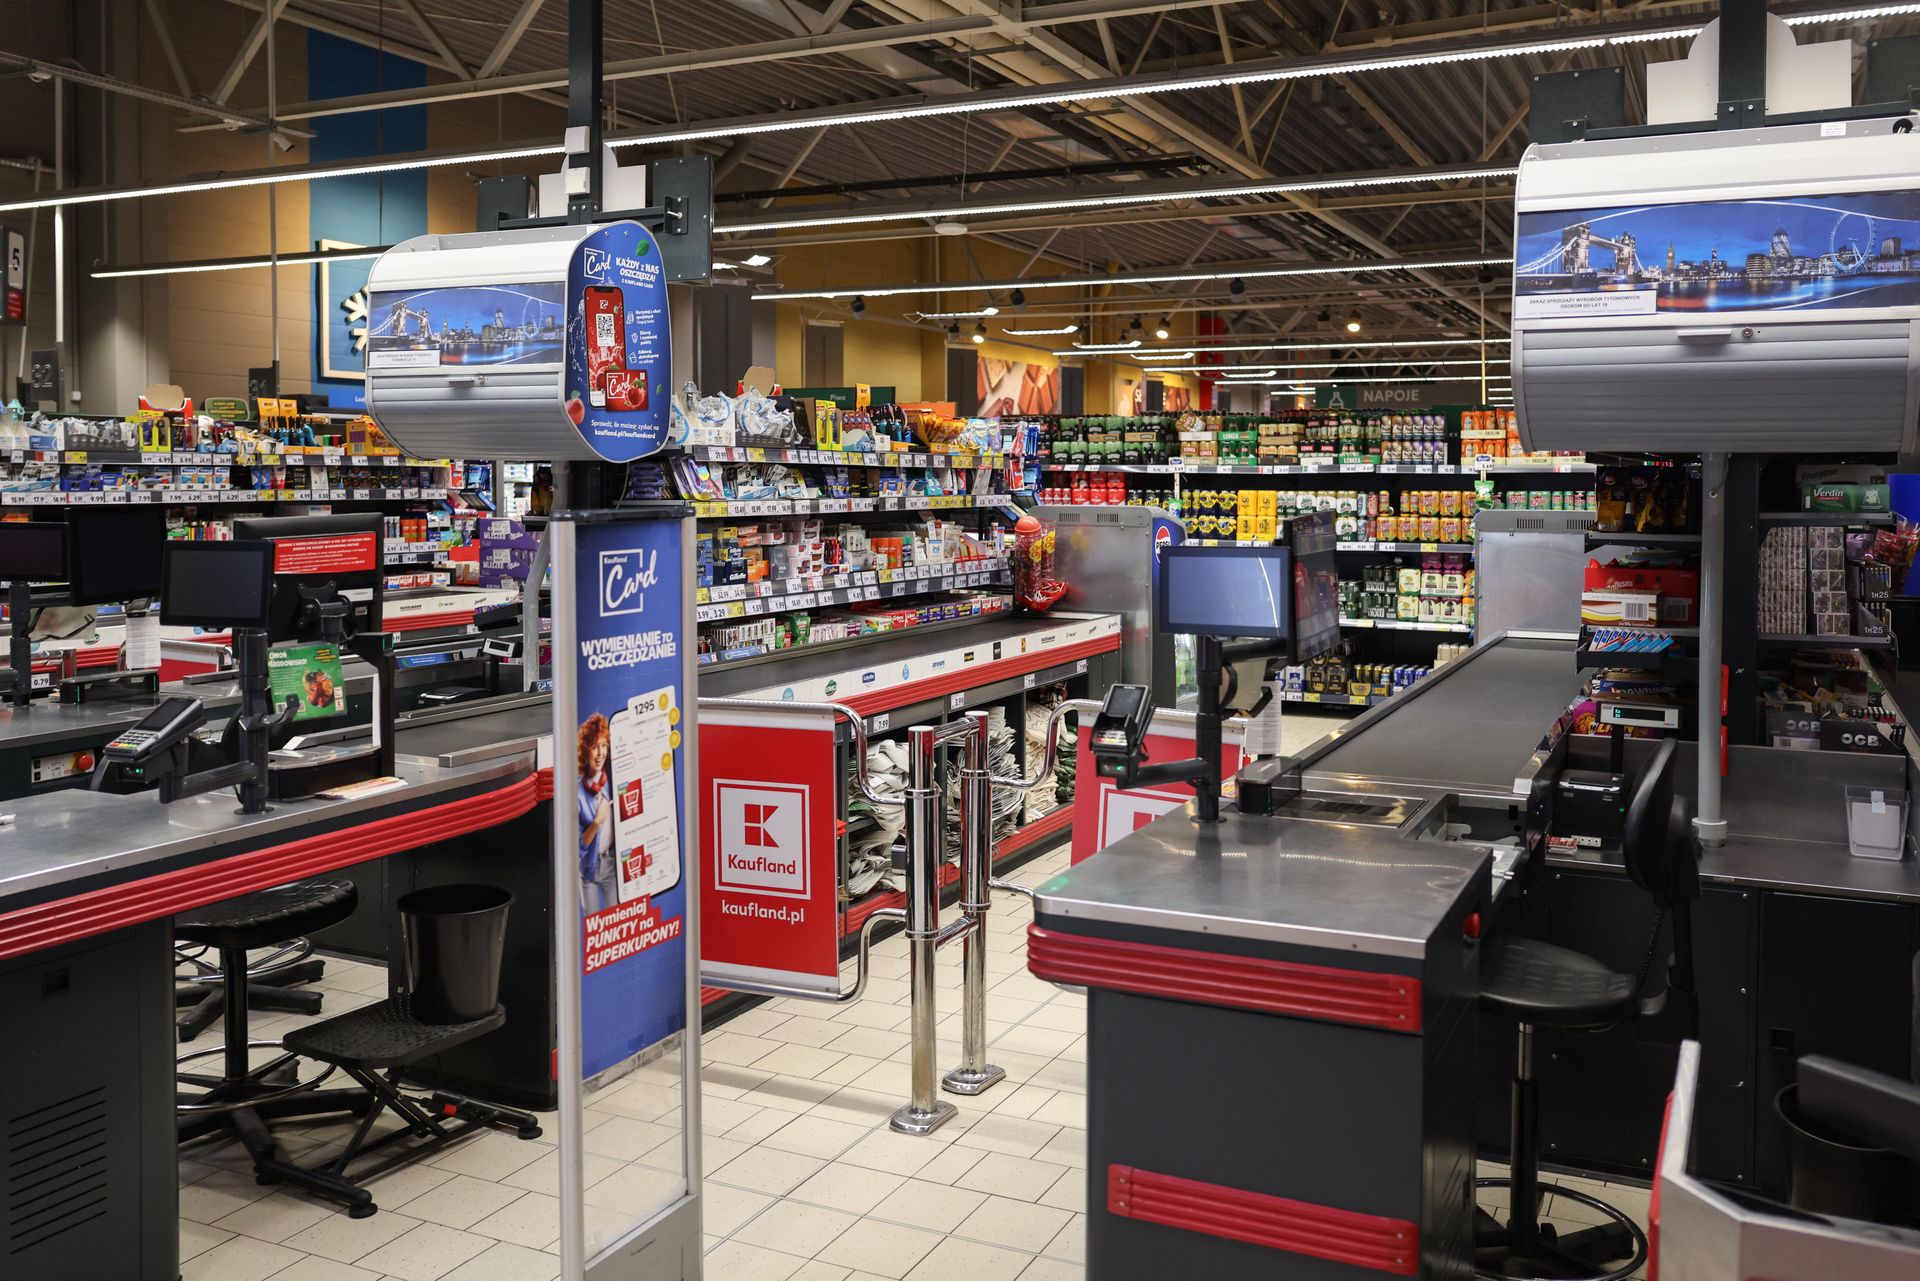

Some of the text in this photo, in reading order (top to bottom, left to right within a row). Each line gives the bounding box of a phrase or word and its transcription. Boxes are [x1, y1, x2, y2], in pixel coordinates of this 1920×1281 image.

[12, 248, 20, 271] 5
[587, 253, 612, 274] Card
[616, 257, 640, 270] KAŻDY
[646, 264, 660, 274] NAS
[32, 363, 52, 388] 32
[610, 373, 631, 396] Card
[1363, 389, 1420, 402] NAPOJE
[1813, 487, 1844, 498] Verdin
[605, 549, 659, 608] Card
[714, 609, 726, 617] 3.29
[581, 630, 673, 657] WYMIENIANIE TO
[588, 642, 676, 670] OSZCZĘDZANIE!
[634, 700, 656, 716] 1295
[1785, 720, 1822, 732] OCB
[1841, 733, 1880, 747] OCB
[728, 854, 796, 875] Kaufland
[586, 898, 648, 932] Wymieniaj
[722, 899, 804, 925] kaufland.pl
[585, 919, 680, 972] SUPERKUPONY!
[586, 916, 654, 952] PUNKTY na
